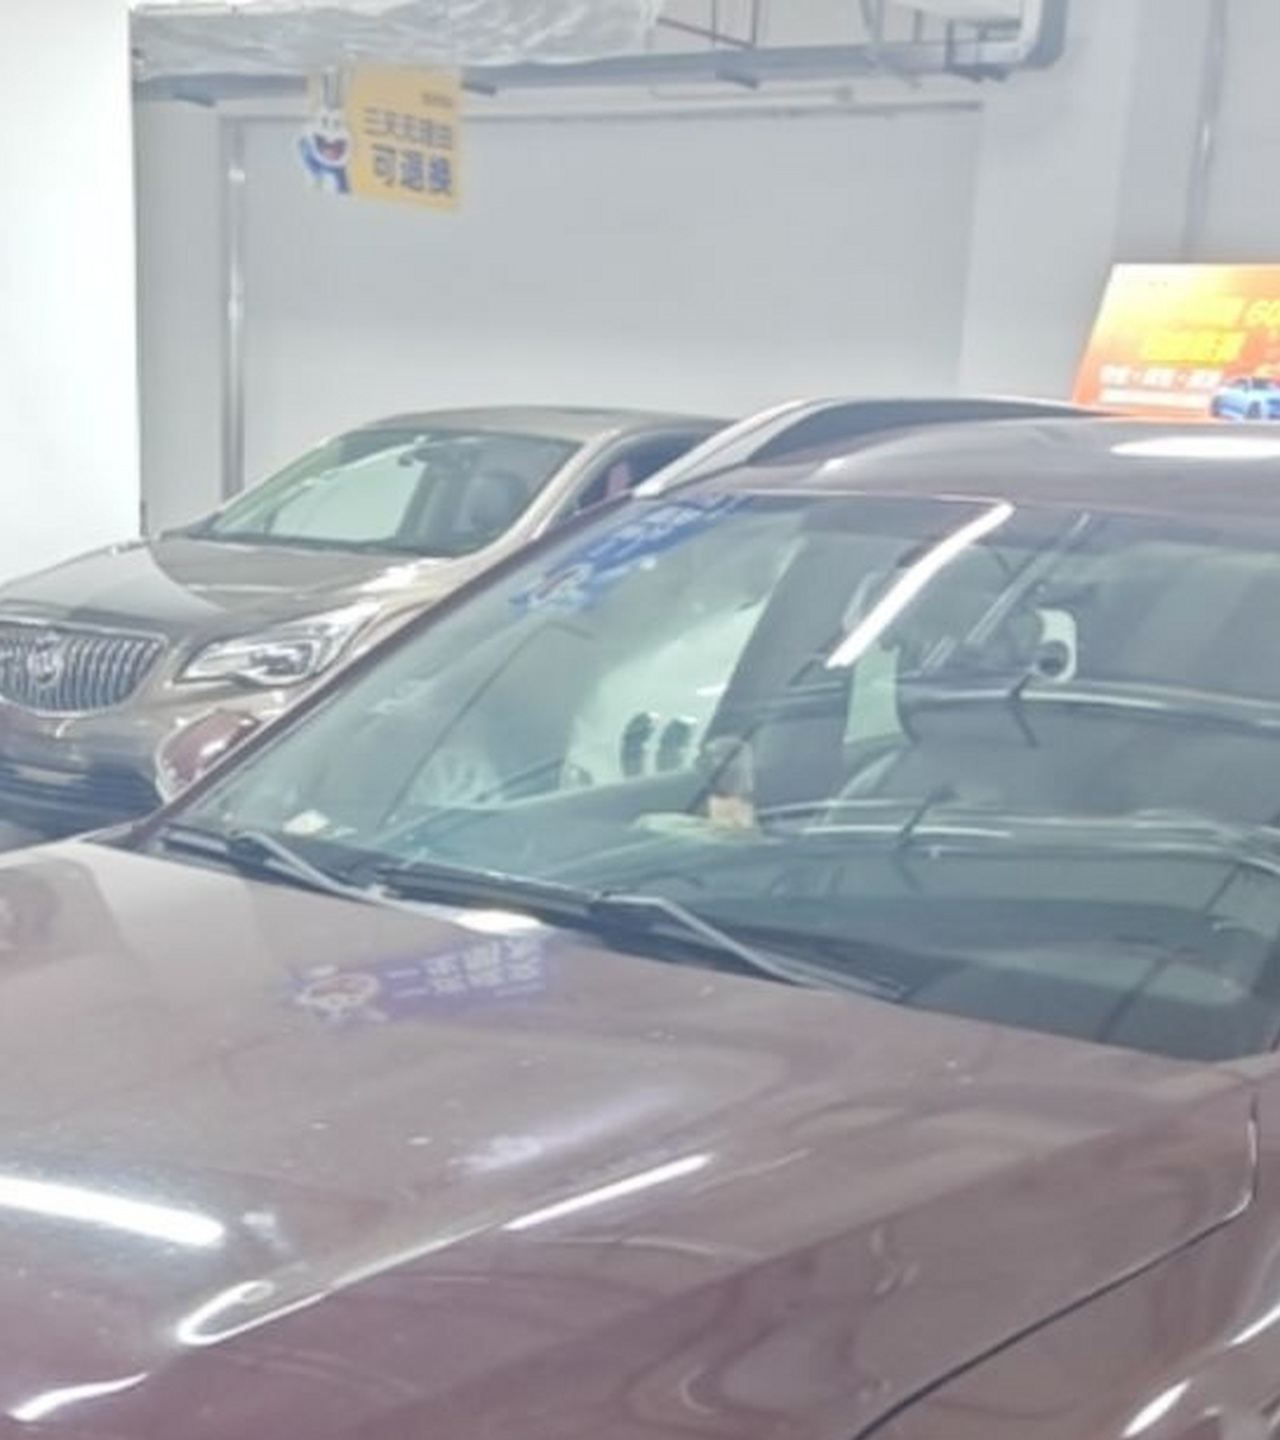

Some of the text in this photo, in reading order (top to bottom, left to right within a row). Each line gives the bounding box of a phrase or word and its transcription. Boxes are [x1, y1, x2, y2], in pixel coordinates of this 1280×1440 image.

[363, 105, 453, 151] 三天无理由
[371, 143, 453, 197] 可退换
